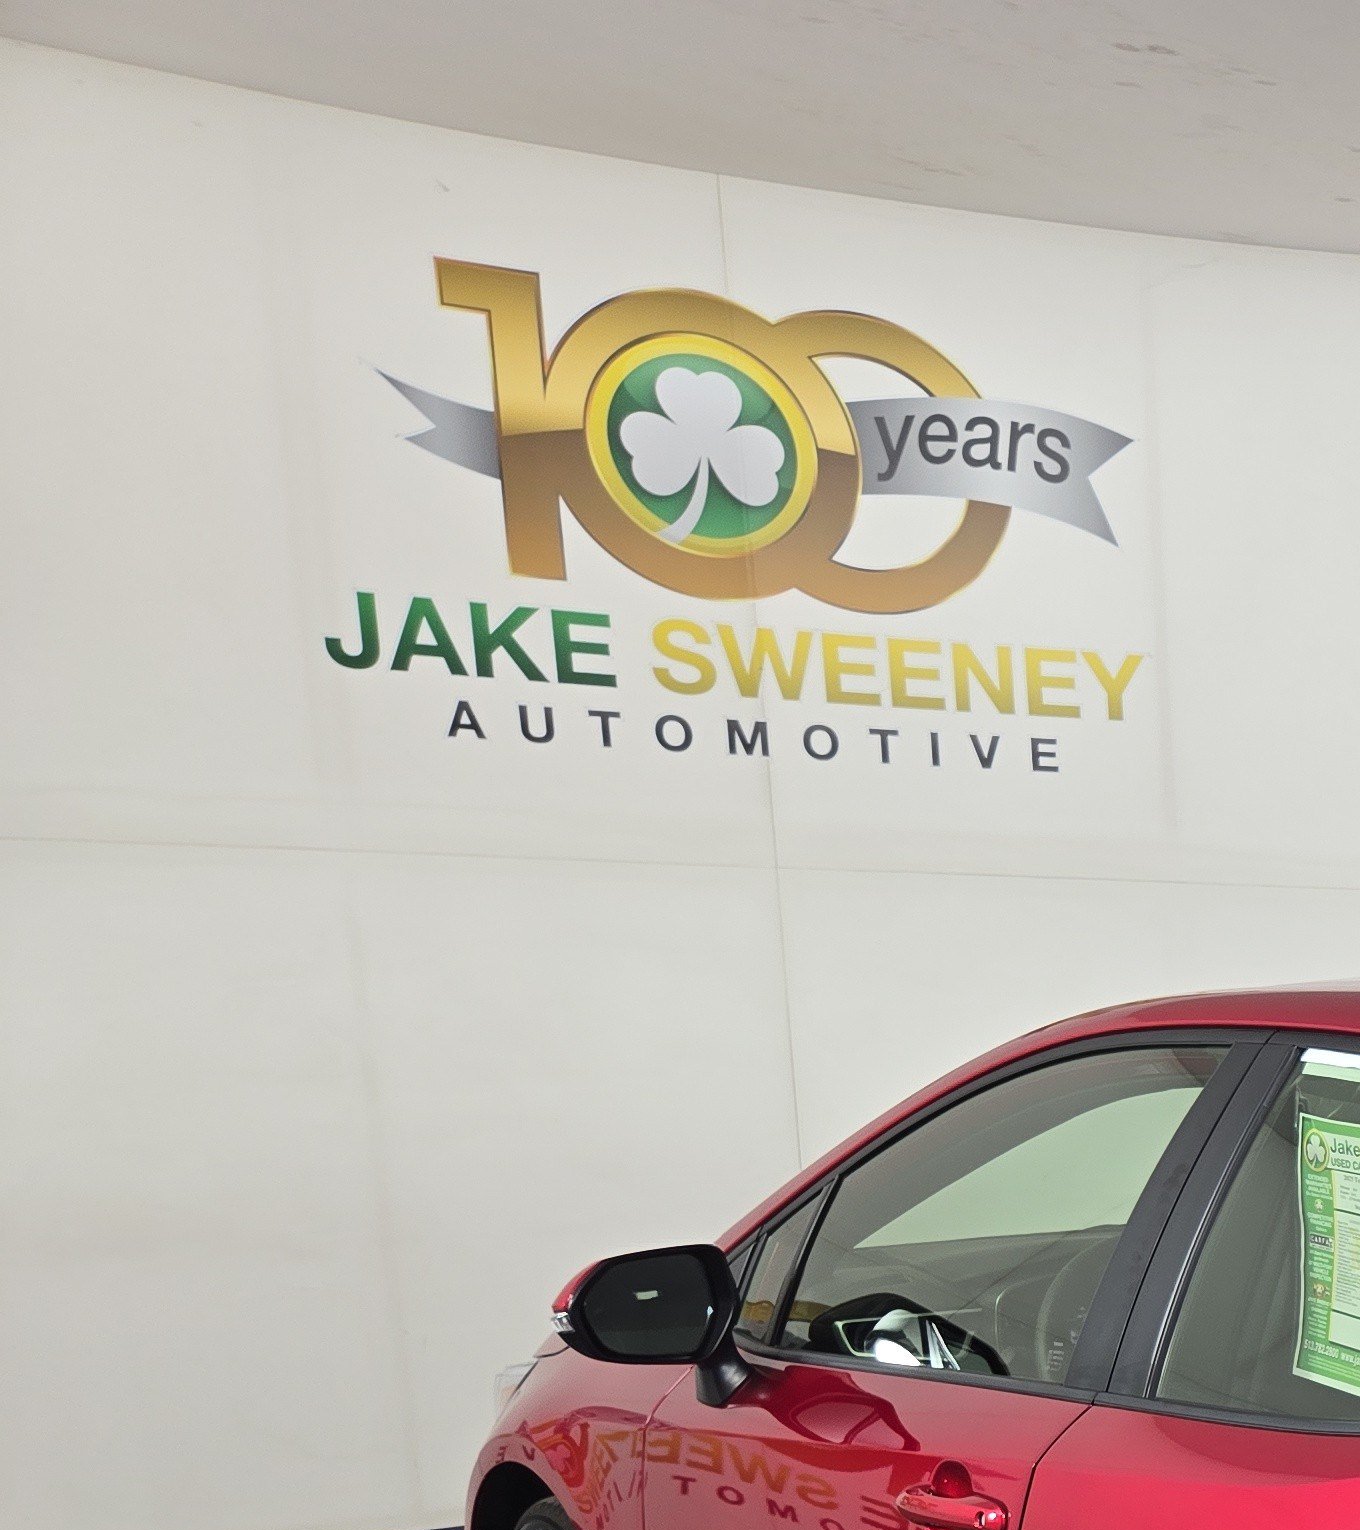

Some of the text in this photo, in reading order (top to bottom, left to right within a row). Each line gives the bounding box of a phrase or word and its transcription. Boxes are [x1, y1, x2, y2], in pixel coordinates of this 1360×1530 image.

[874, 413, 1072, 484] years
[325, 591, 1144, 722] JAKE SWEENEY
[447, 700, 1061, 774] AUTOMOTIVE
[1331, 1157, 1351, 1169] USED
